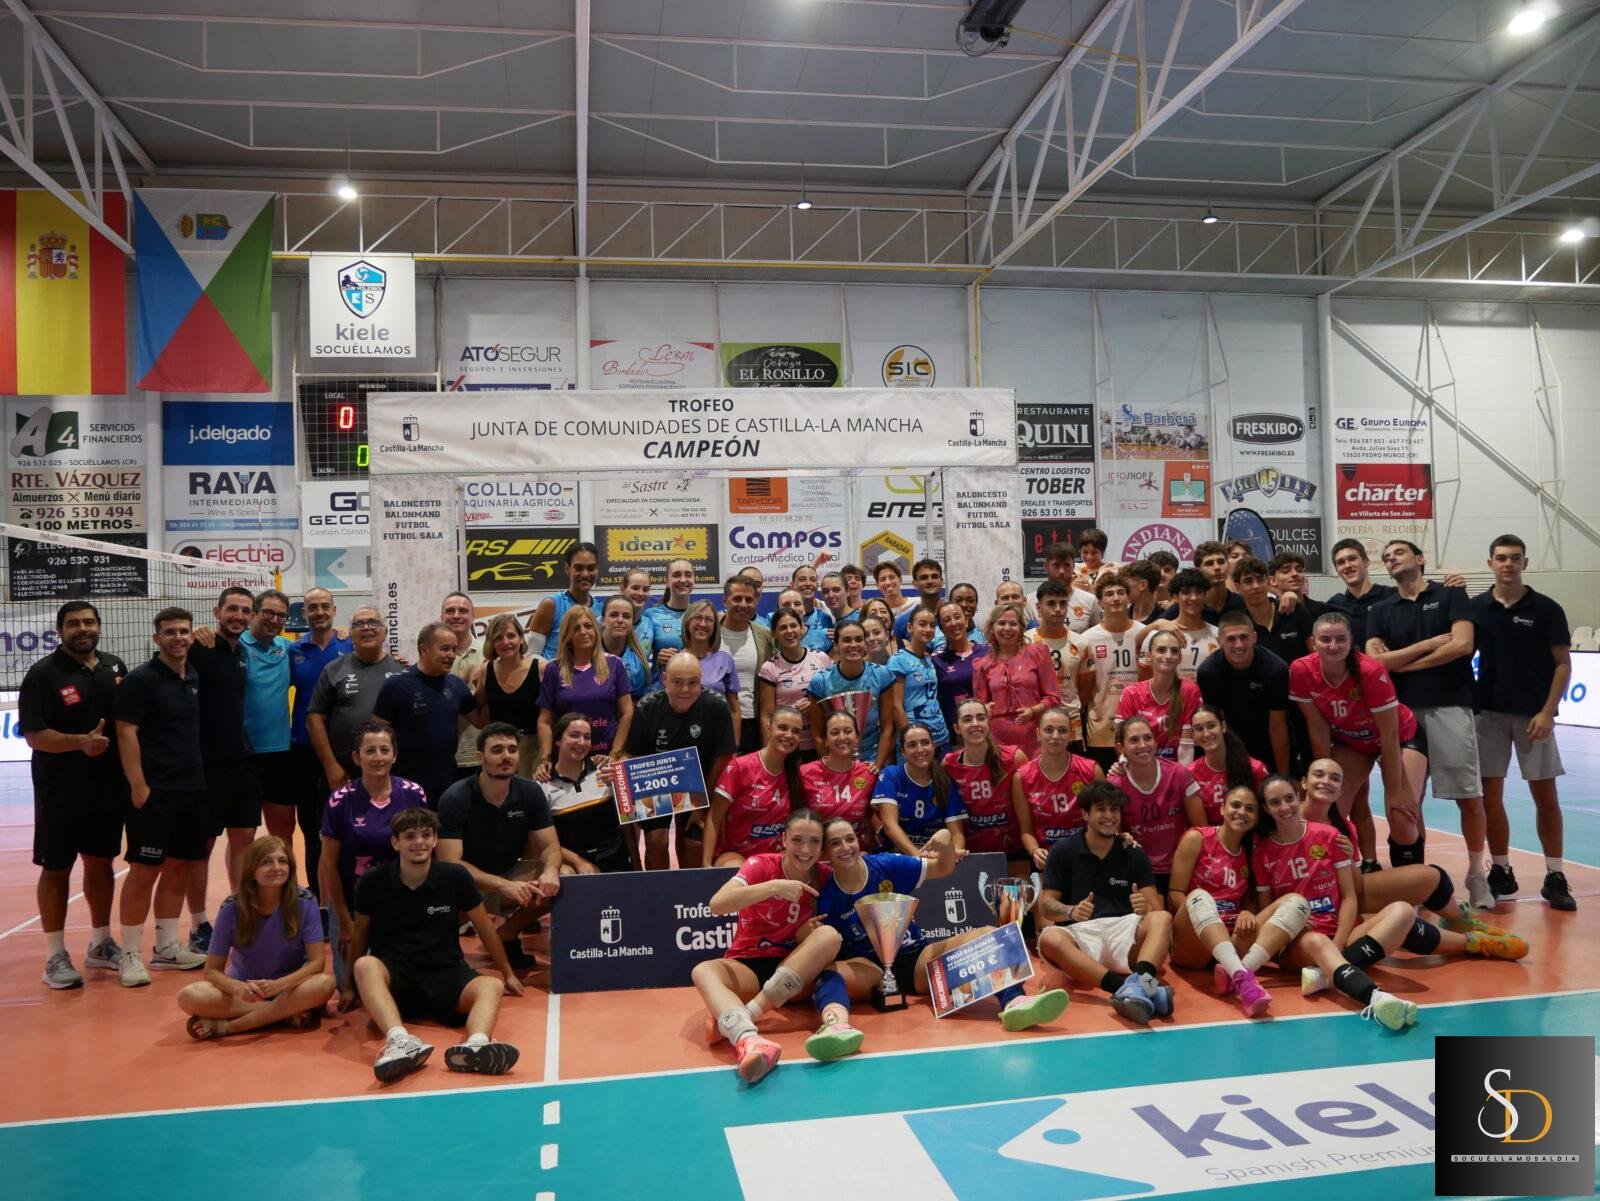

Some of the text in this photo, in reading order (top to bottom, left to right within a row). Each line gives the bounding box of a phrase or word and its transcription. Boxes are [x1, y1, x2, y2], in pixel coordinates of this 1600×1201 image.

[336, 322, 390, 341] kiele
[316, 343, 411, 355] SOCUÉLLAMOS
[739, 368, 825, 380] EL ROSILLO
[888, 362, 929, 376] SIC
[668, 398, 734, 413] TROFEO
[1016, 407, 1091, 415] RESTAURANTE
[340, 406, 354, 429] 0
[1335, 417, 1356, 430] GE
[1361, 417, 1391, 427] GRUPO
[1393, 418, 1428, 427] EUROPA
[89, 423, 136, 432] SERVICIOS
[470, 417, 924, 440] JUNTA DE COMUNIDADES DE CASTILLA-LA MANCHA
[1016, 420, 1090, 448] QUINI
[1236, 421, 1298, 438] FRESKIBO
[83, 434, 143, 443] FINANCIEROS
[643, 435, 760, 459] CAMPEÓN
[1239, 449, 1296, 457] WWW.FRESKIBO.ES
[55, 469, 141, 488] VÁZQUEZ
[1020, 467, 1091, 475] CENTRO LOGÍSTICO
[189, 471, 277, 495] RAYA
[630, 480, 668, 494] Sastre
[1026, 477, 1086, 494] TOBER
[1285, 475, 1311, 497] BAR
[1345, 481, 1428, 502] charter
[13, 490, 141, 502] Almuerzos Menú diario
[189, 498, 277, 507] INTERMEDIARIOS
[956, 491, 1008, 499] BALONCESTO
[36, 505, 134, 519] 926 530 494
[207, 508, 227, 517] Wine
[229, 508, 235, 516] &
[383, 500, 442, 508] BALONCESTO
[957, 501, 1007, 509] BALONMANO
[1022, 508, 1076, 517] 926 53 01 58
[384, 510, 441, 519] BALONMANO
[967, 511, 999, 519] FUTBOL
[35, 520, 62, 531] 100
[395, 521, 431, 529] FUTBOL
[989, 521, 1011, 529] SALA
[383, 531, 444, 540] FUTBOL SALA
[729, 526, 842, 549] Campos
[1125, 526, 1193, 562] INDIANA
[205, 543, 285, 563] electria
[883, 536, 911, 555] RABADÁN
[47, 555, 110, 566] 926 530 931
[731, 553, 805, 563] Centro Medico
[1113, 649, 1131, 668] 10
[1191, 647, 1200, 666] 7
[1331, 699, 1348, 718] 16
[628, 756, 677, 771] TROFEO JUNTA
[615, 764, 631, 813] CAMPEONAS
[633, 775, 680, 793] 1.200 €
[970, 780, 993, 800] 28
[833, 784, 852, 804] 14
[914, 800, 926, 819] 8
[1050, 793, 1069, 813] 13
[1287, 857, 1311, 880] 12
[1222, 866, 1237, 889] 18
[674, 903, 719, 919] Trofe
[786, 902, 800, 924] 9
[945, 946, 974, 962] TROFEO
[974, 936, 996, 951] JUNTA
[958, 960, 985, 978] 600
[988, 954, 998, 965] €
[1130, 1081, 1435, 1159] kiel
[1204, 1157, 1324, 1184] Spanish
